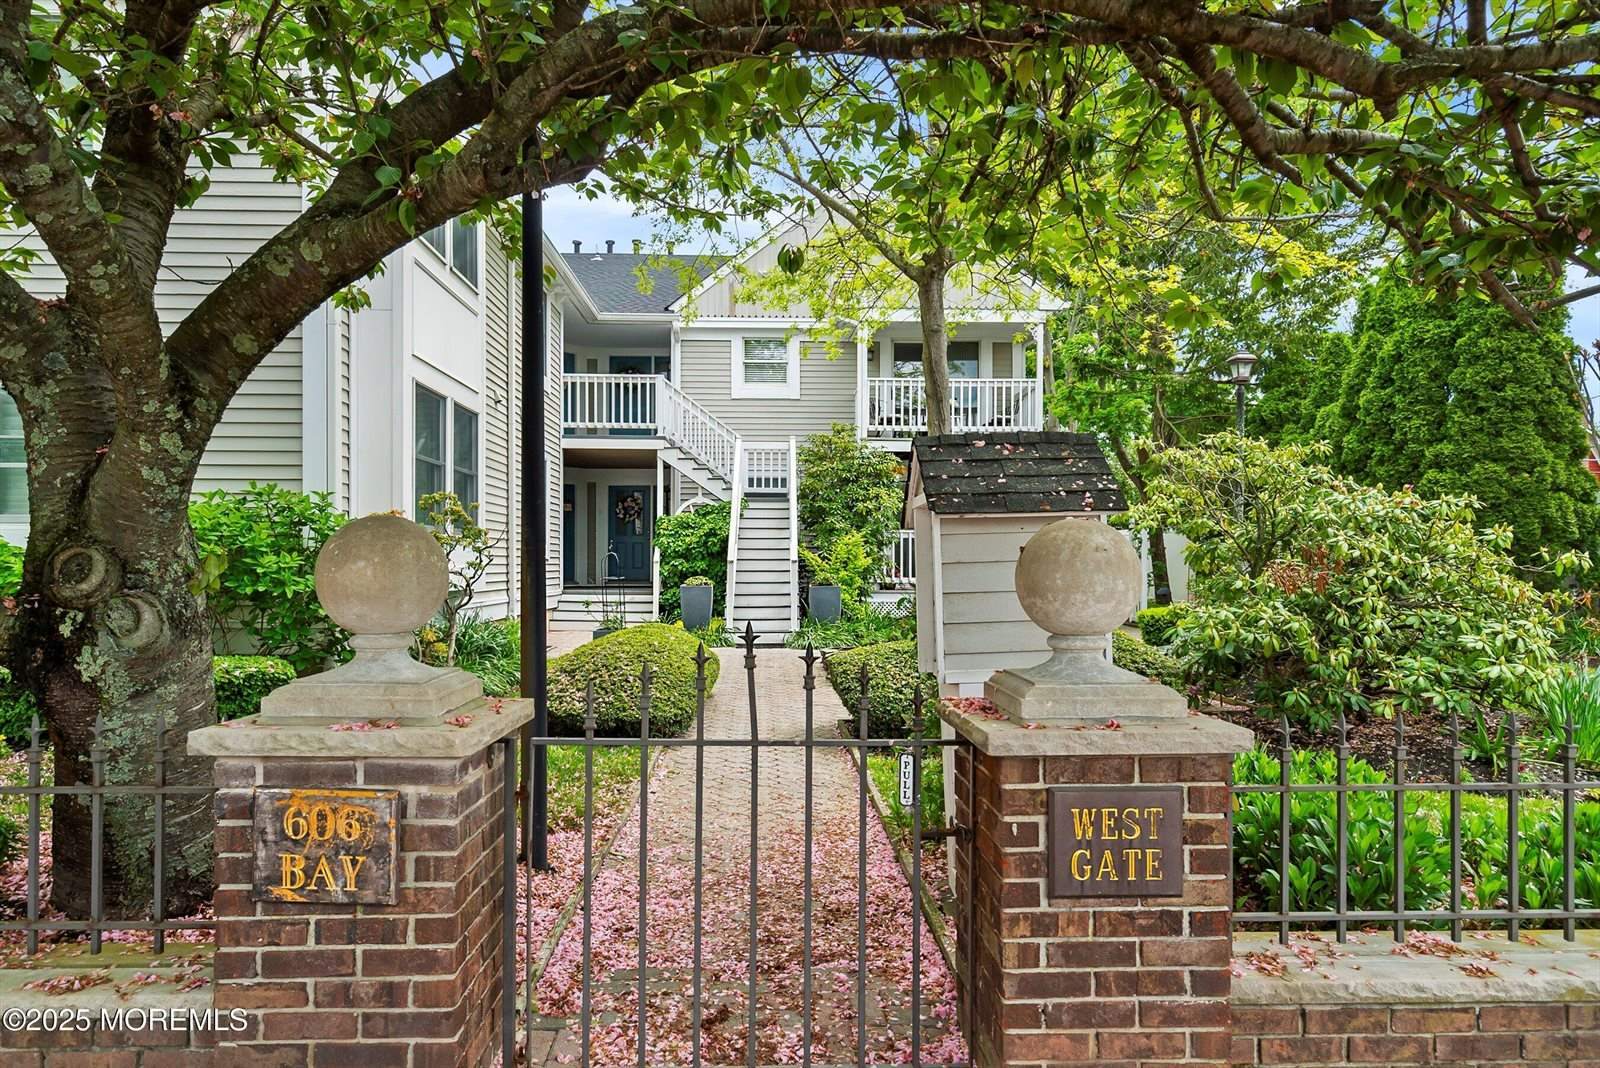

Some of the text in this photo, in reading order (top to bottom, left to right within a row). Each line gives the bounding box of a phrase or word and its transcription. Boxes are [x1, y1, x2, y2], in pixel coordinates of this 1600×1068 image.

[903, 760, 911, 800] PULL
[283, 806, 361, 841] 606
[1071, 807, 1164, 840] WEST
[278, 852, 366, 892] BAY
[1071, 849, 1163, 881] GATE
